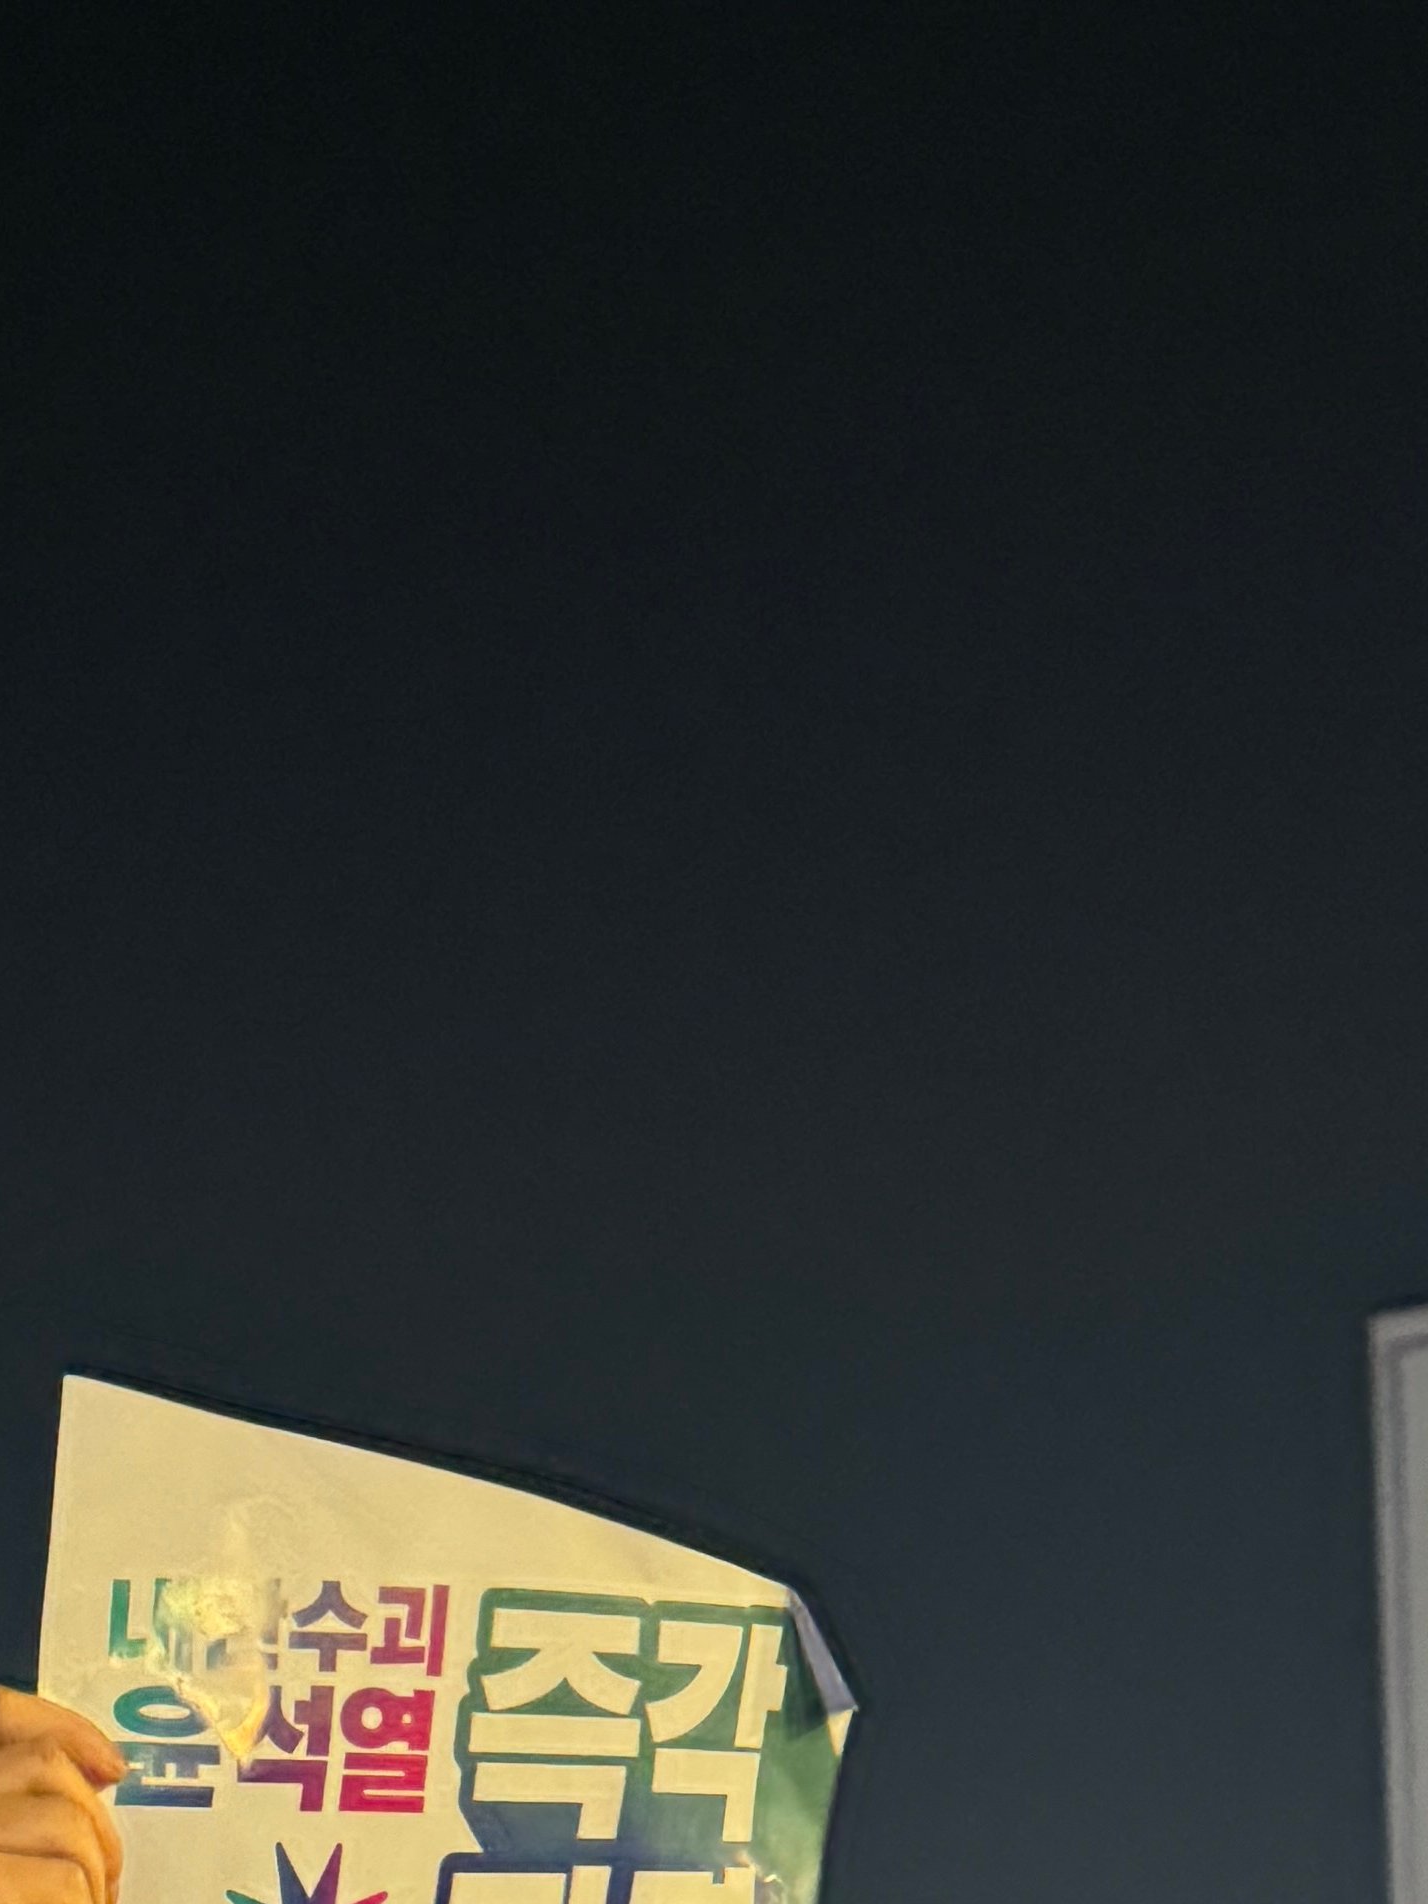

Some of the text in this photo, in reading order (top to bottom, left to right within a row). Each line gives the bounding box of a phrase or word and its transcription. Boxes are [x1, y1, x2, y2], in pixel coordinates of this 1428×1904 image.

[107, 1577, 450, 1677] 내수괴
[112, 1684, 437, 1814] 윤석열
[468, 1607, 788, 1843] 즉각
